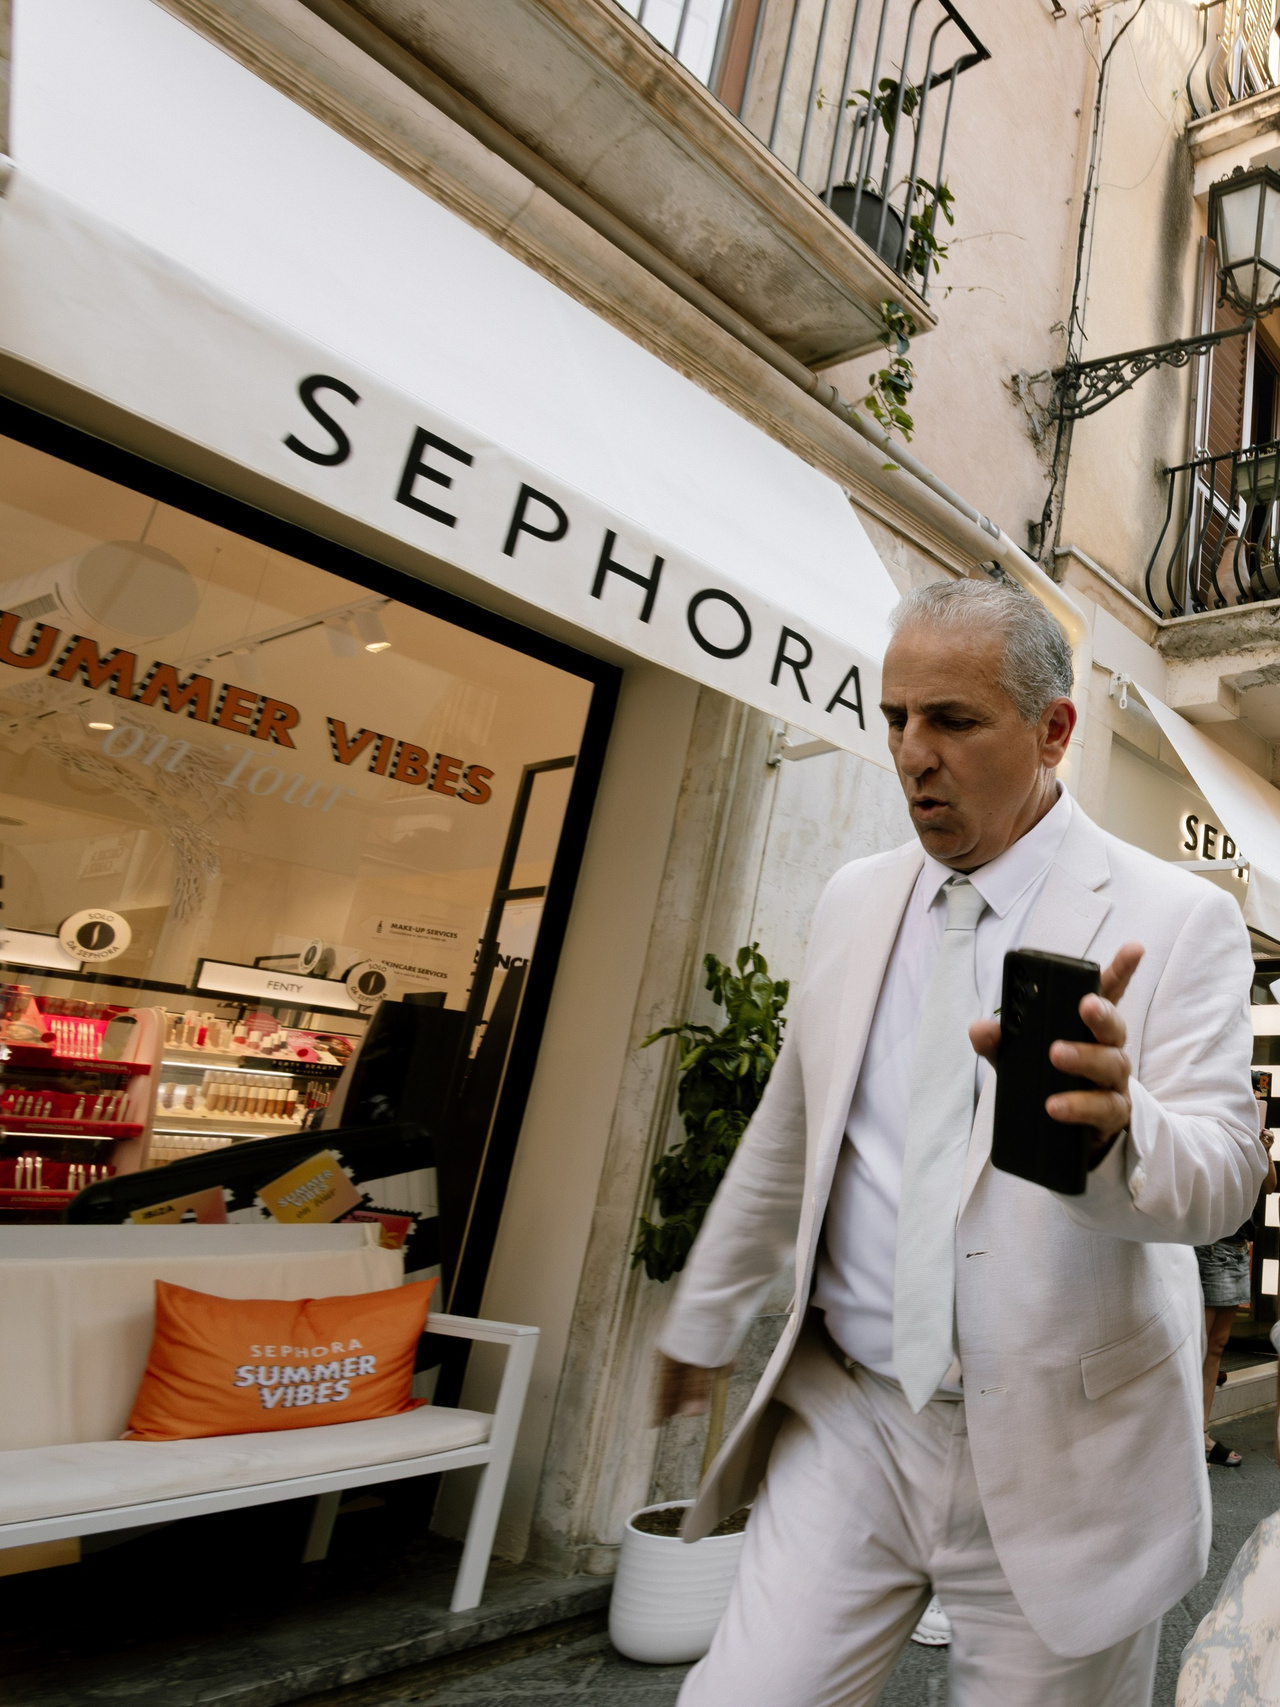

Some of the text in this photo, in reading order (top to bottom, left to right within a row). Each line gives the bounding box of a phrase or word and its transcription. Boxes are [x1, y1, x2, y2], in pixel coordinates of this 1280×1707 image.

[283, 374, 867, 731] SEPHORA
[101, 725, 356, 813] on Tour
[326, 716, 495, 805] VIBES
[88, 912, 115, 922] SOLO
[390, 922, 426, 934] MAKE-UP
[426, 928, 458, 939] SERVICES
[77, 945, 120, 959] SEPHORA
[417, 963, 448, 979] SERVICES
[266, 980, 304, 993] FENTY
[249, 1338, 363, 1359] SEPHORA
[232, 1354, 377, 1388] SUMMER
[258, 1379, 352, 1410] VIBES
